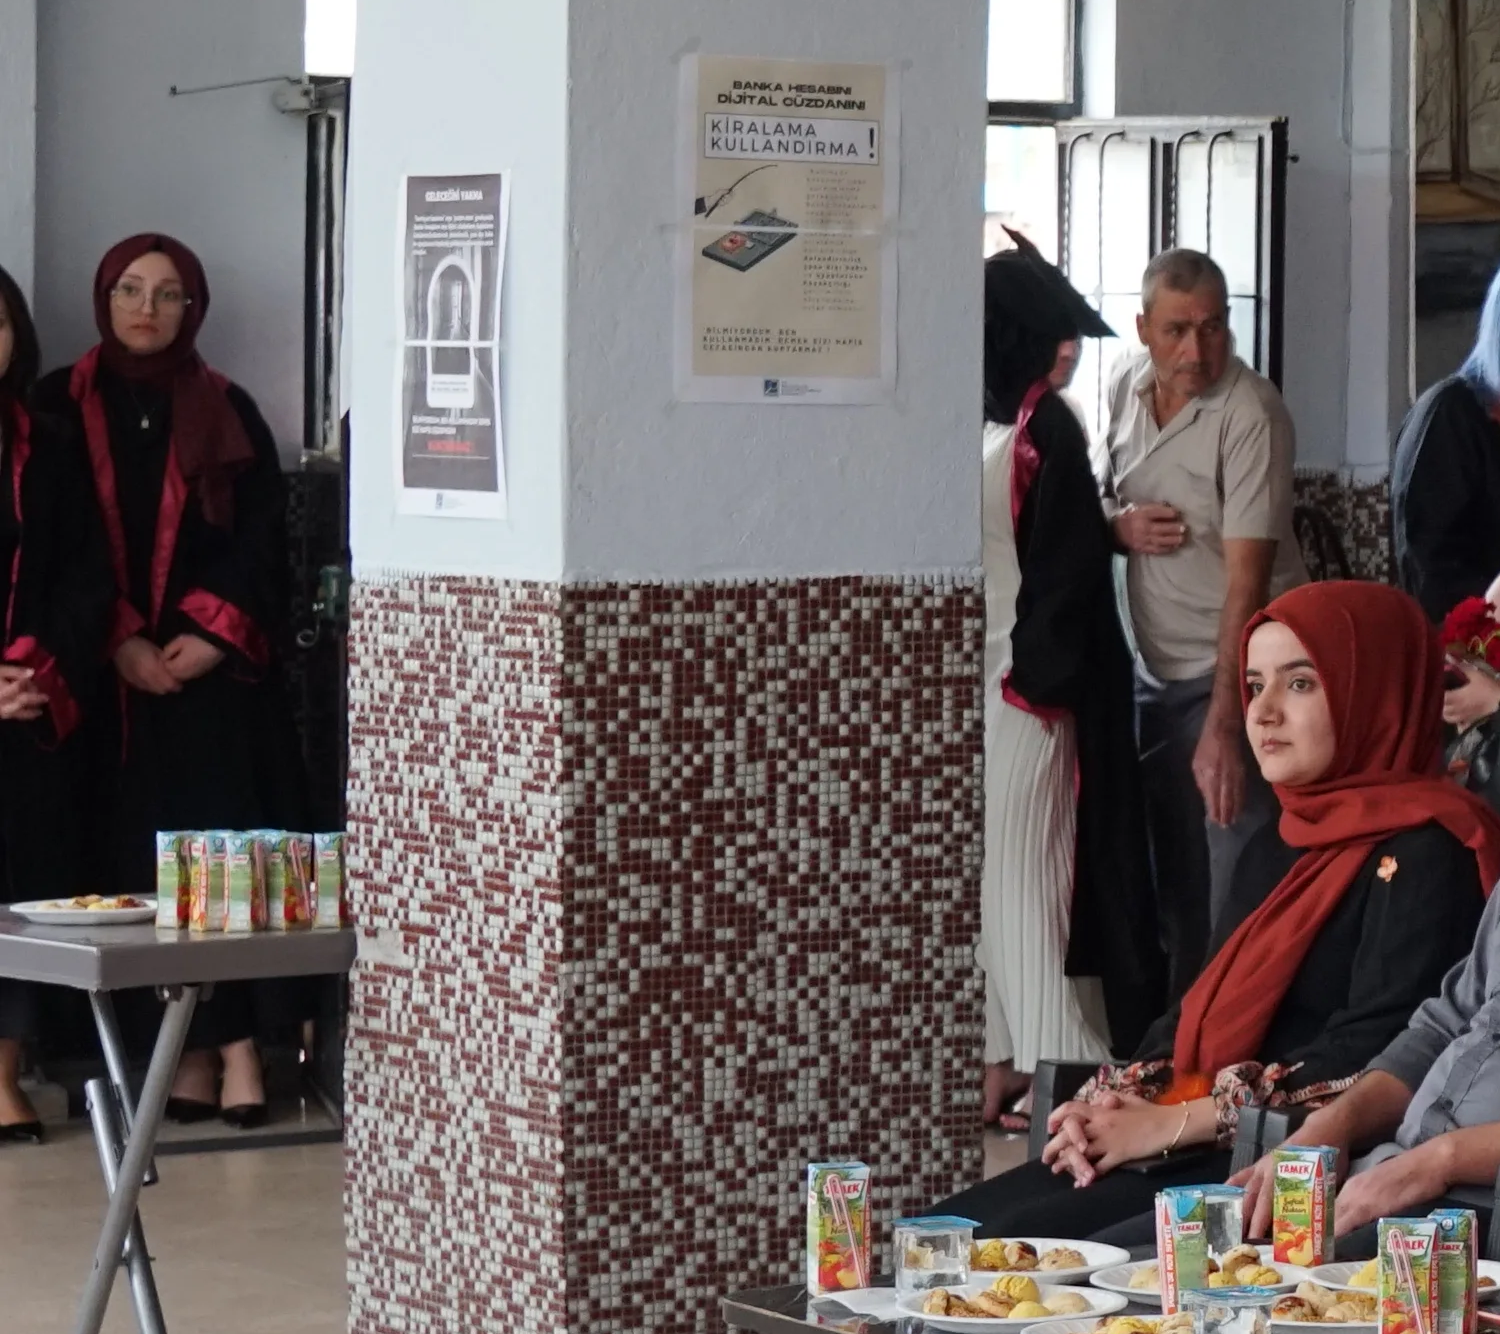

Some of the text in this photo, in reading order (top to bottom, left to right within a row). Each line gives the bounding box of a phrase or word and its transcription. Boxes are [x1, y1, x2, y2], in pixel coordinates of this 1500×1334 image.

[732, 80, 852, 96] BANKA HESABINI
[717, 91, 866, 111] DİJİTAL CÜZDANINI
[711, 116, 817, 137] KİRALAMA
[1279, 1164, 1310, 1174] TAMEK
